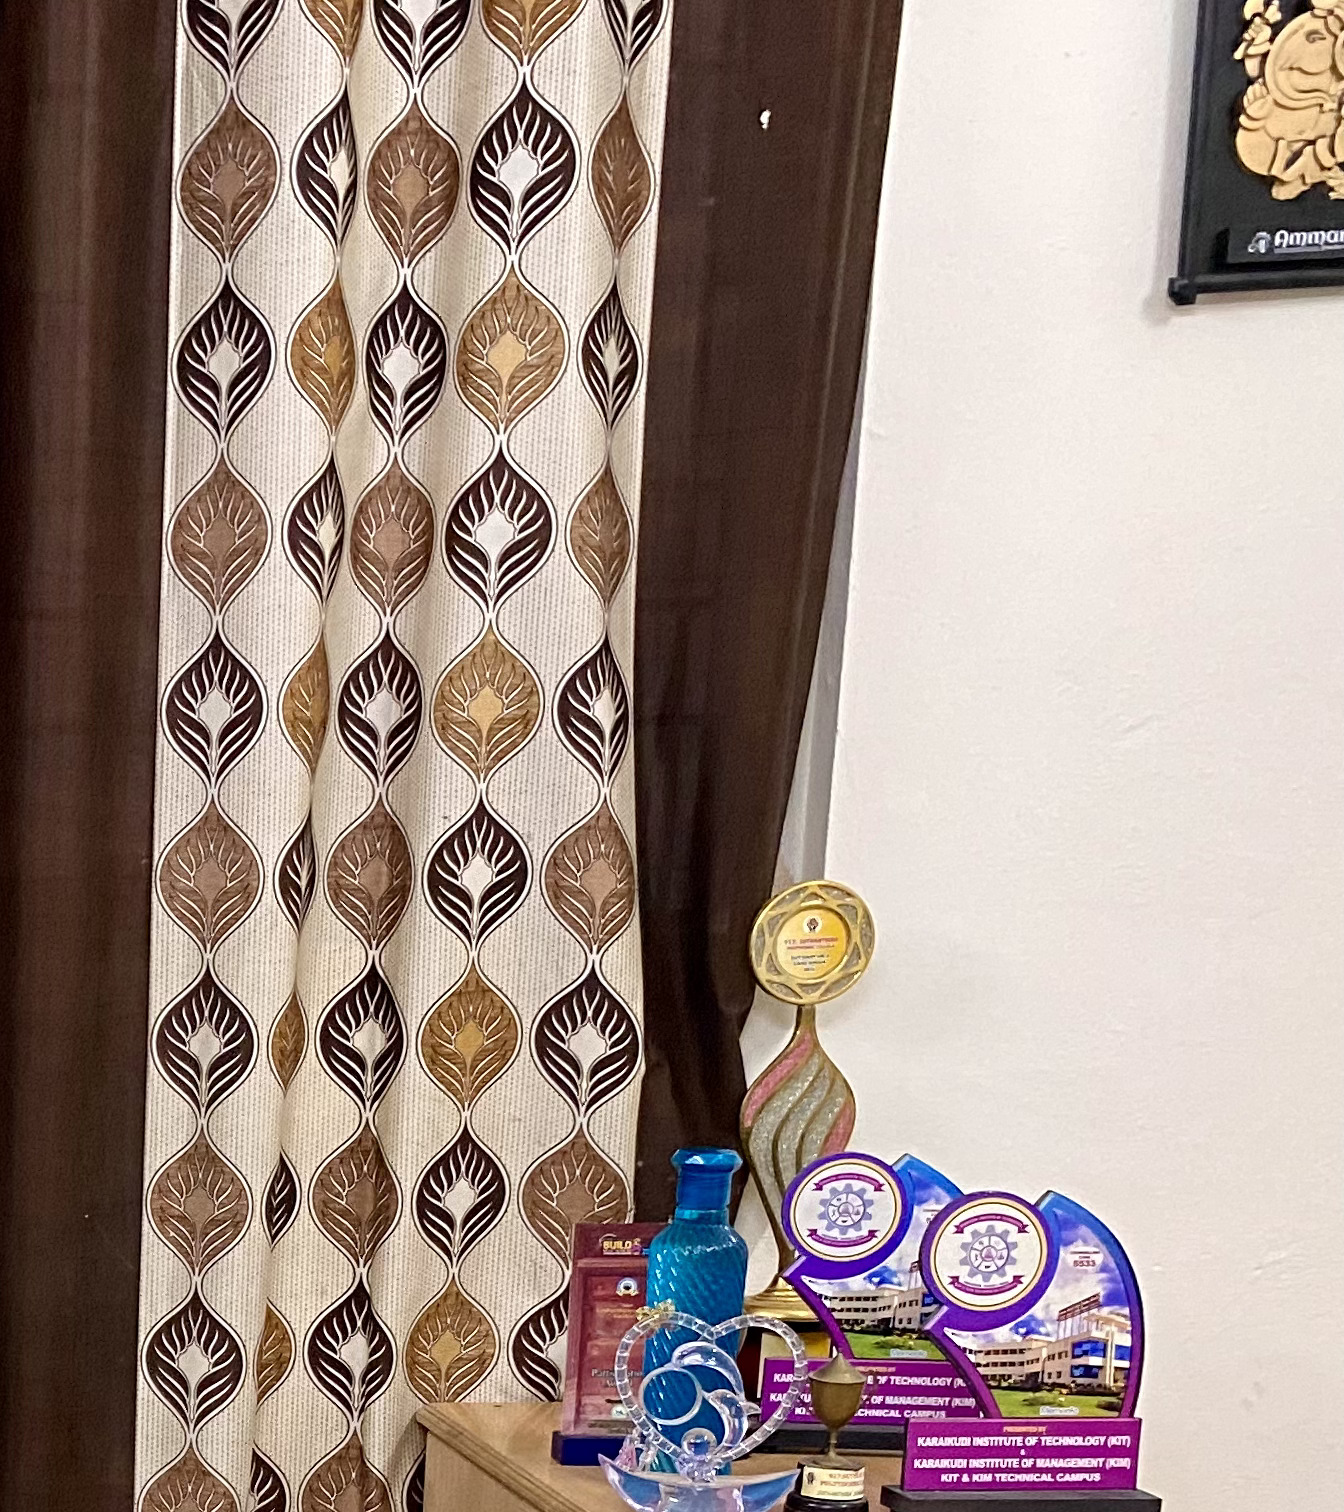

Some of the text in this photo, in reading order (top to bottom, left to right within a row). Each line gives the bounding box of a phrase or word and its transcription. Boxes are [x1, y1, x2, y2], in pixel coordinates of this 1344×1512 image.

[889, 1375, 953, 1387] TECHNOLOGY
[917, 1436, 972, 1447] KARAIKUDI
[972, 1436, 1024, 1447] INSTITUTE
[1024, 1436, 1039, 1446] OF
[1040, 1436, 1107, 1446] TECHNOLOGY
[913, 1458, 968, 1469] KARAIKUDI
[968, 1458, 1020, 1469] INSTITUTE
[1020, 1458, 1035, 1468] OF
[1036, 1458, 1105, 1468] MANAGEMENT
[940, 1473, 960, 1483] KIT
[994, 1473, 1055, 1482] TECHNICAL
[1056, 1473, 1101, 1482] CAMPUS
